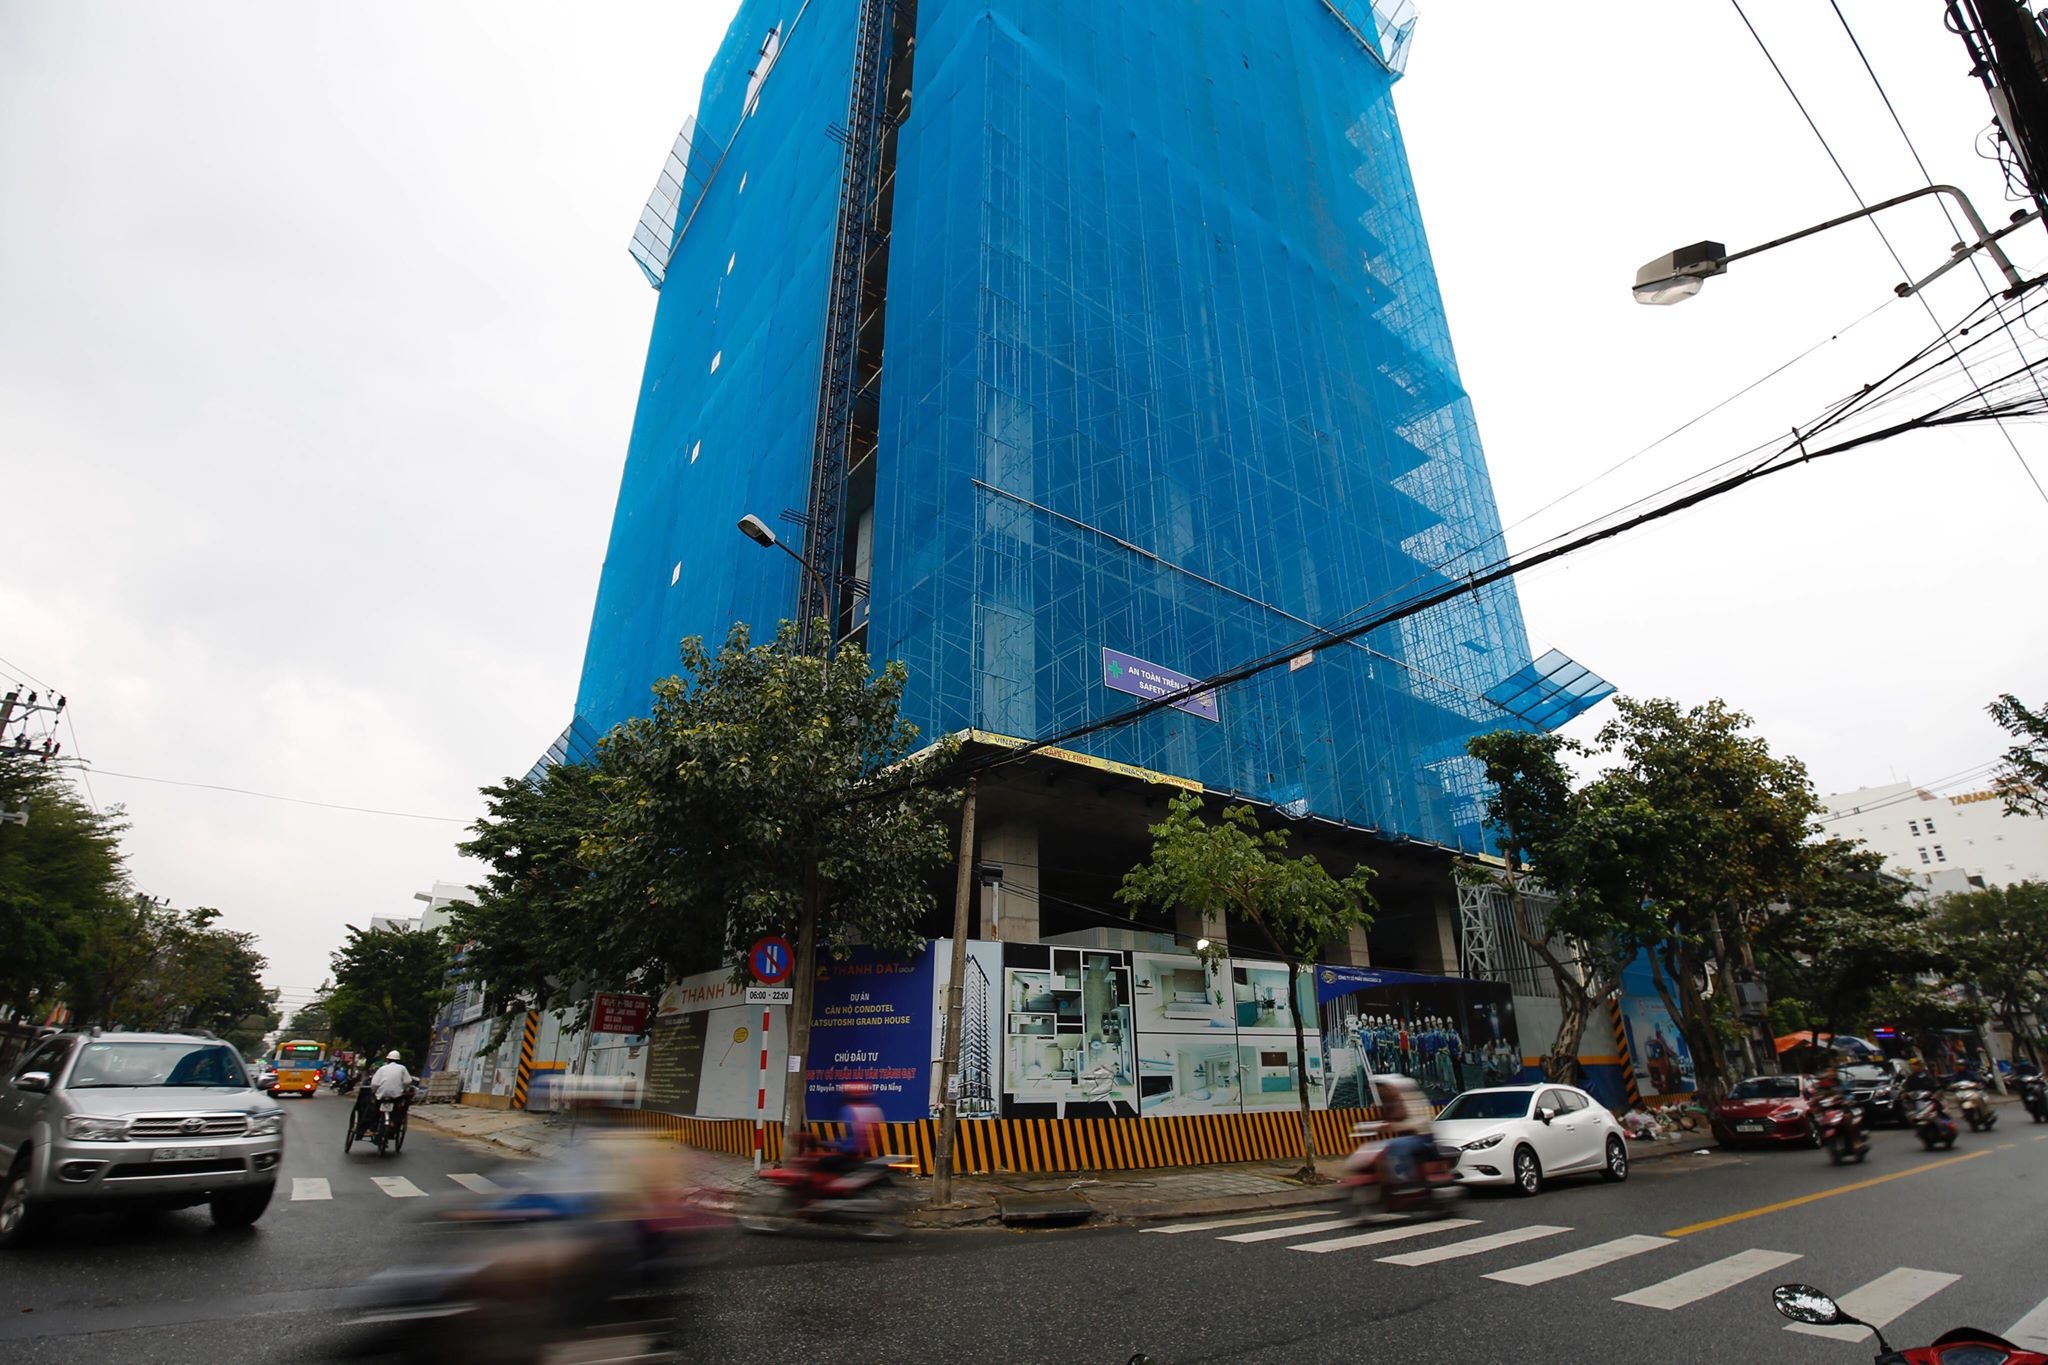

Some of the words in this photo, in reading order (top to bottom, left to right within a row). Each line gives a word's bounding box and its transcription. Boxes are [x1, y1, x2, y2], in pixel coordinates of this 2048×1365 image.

[1128, 666, 1140, 676] AN
[1141, 671, 1161, 683] TOÀN
[1139, 681, 1166, 696] SAFETY
[681, 982, 726, 1005] THANH
[749, 991, 767, 1000] 06:00
[772, 991, 789, 1000] 22:00
[854, 1004, 895, 1013] CONDOTEL
[856, 1017, 883, 1026] GRAND
[884, 1016, 911, 1025] HOUSE
